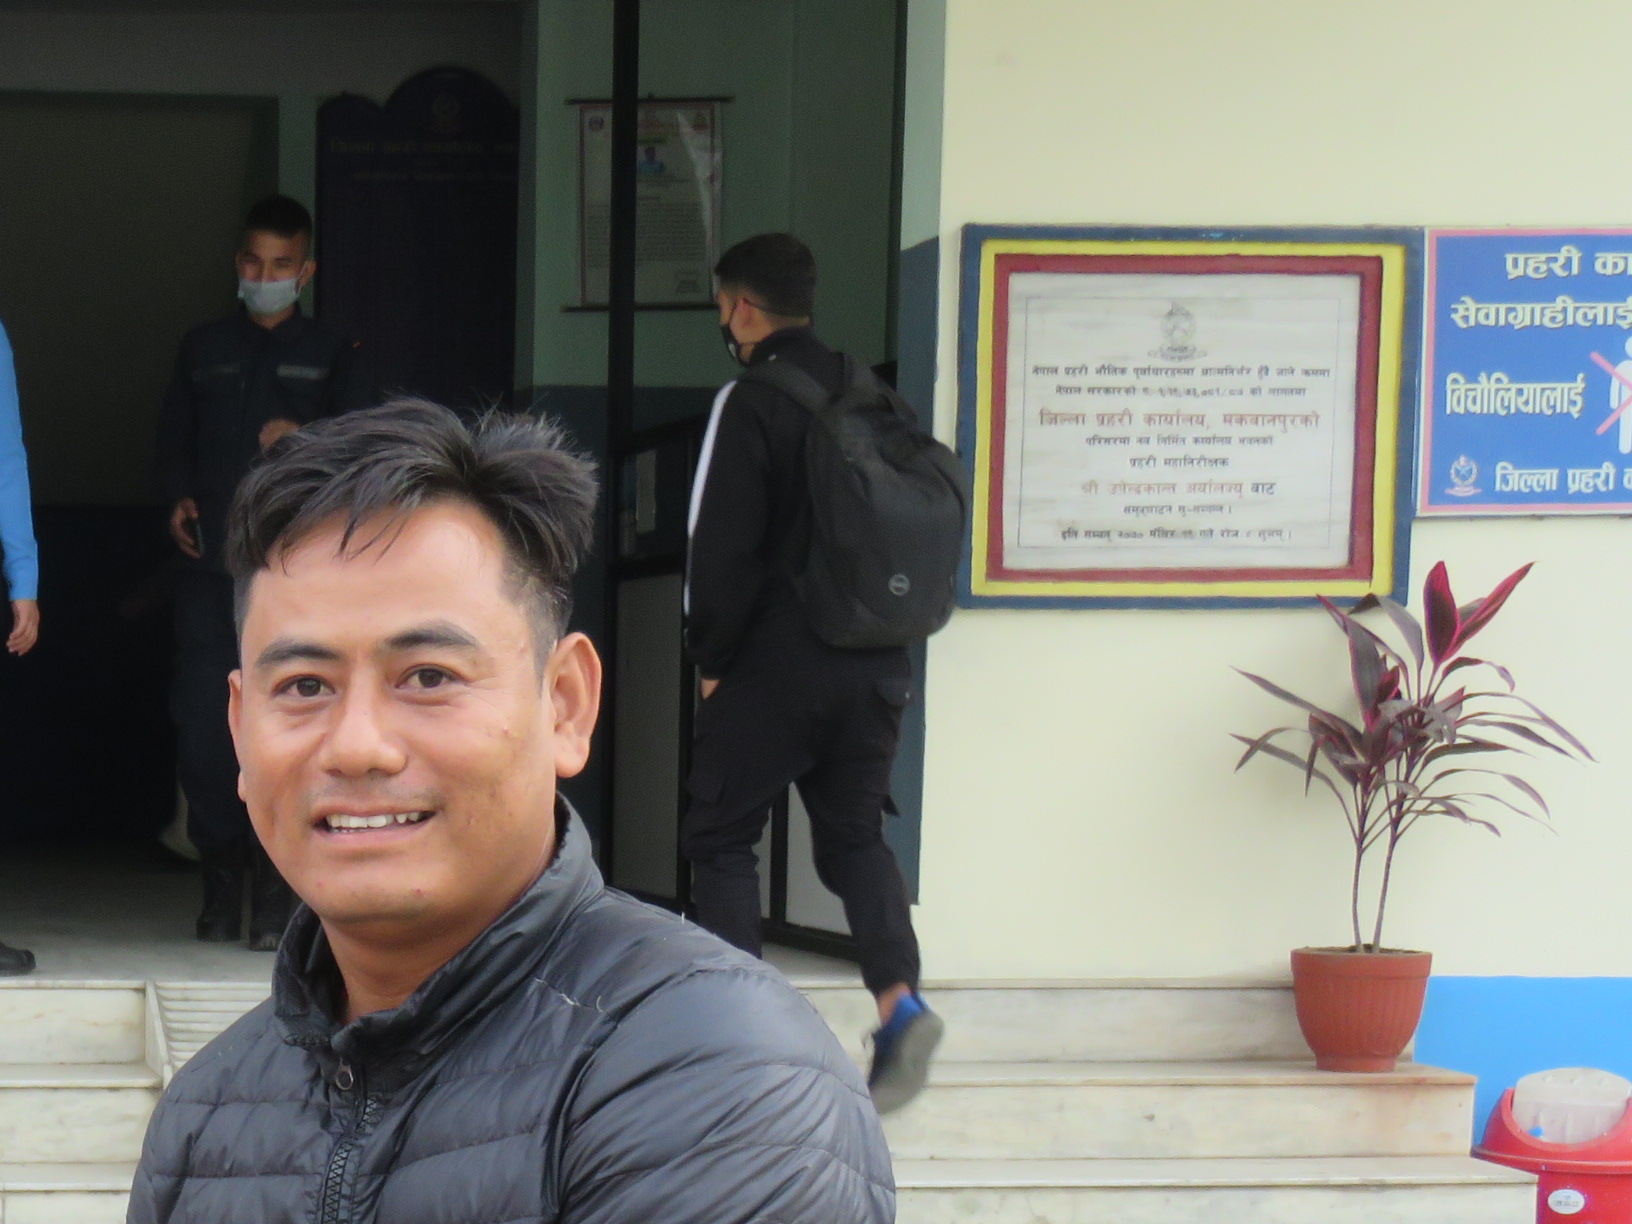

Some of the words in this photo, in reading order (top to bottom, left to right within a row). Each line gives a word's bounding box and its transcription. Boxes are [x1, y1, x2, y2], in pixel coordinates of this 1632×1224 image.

[1504, 244, 1583, 280] प्रहरी
[1594, 252, 1632, 276] का
[1445, 371, 1586, 420] विचौलियालाई
[1039, 407, 1086, 426] जिल्ला
[1096, 407, 1133, 427] प्रहरी
[1129, 455, 1156, 468] प्रहरी
[1494, 461, 1559, 493] जिल्ला
[1567, 461, 1617, 494] प्रहरी
